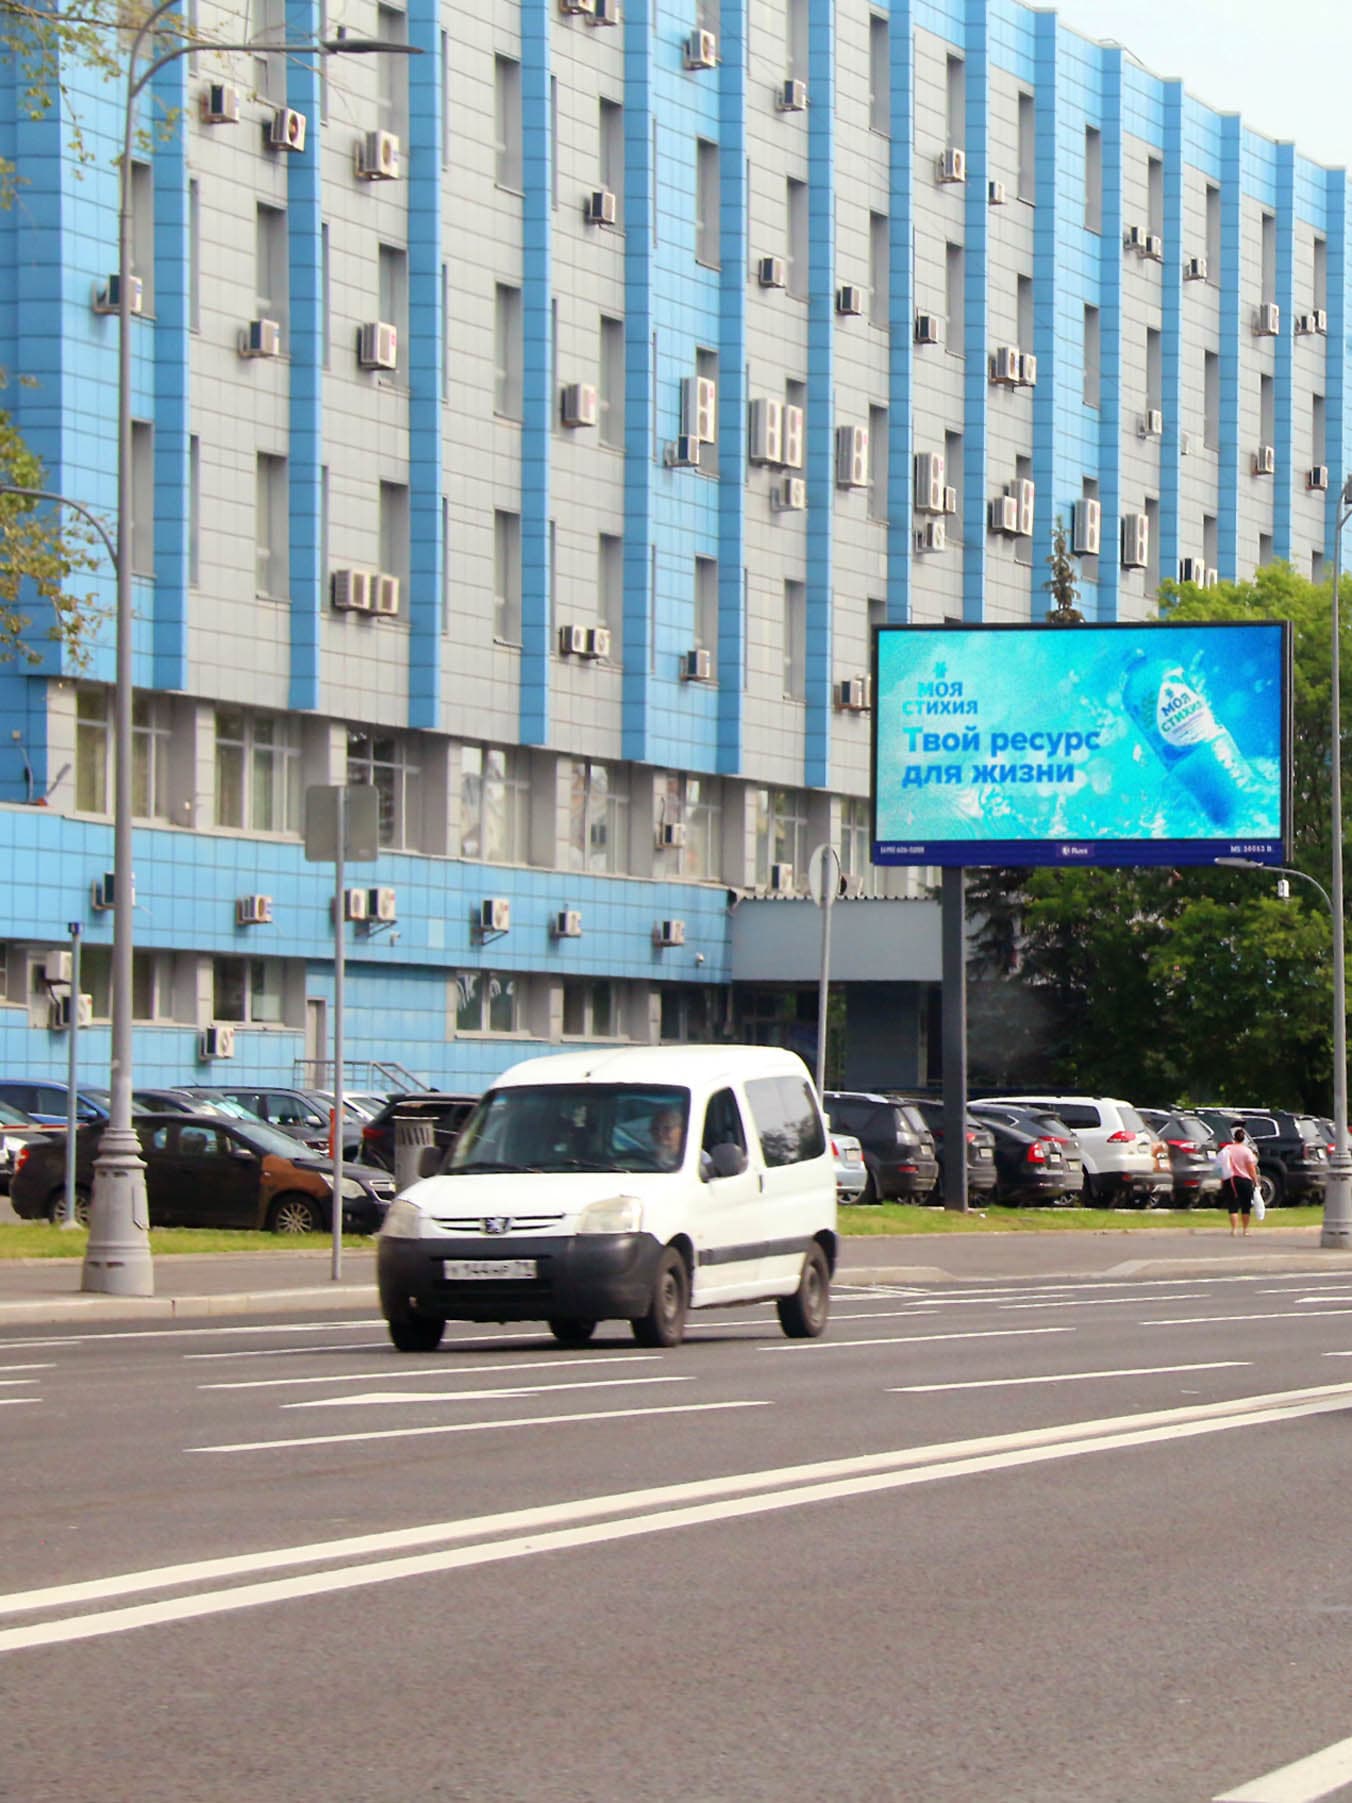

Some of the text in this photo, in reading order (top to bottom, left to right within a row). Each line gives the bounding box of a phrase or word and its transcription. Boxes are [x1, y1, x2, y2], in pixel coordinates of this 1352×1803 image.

[917, 681, 963, 698] МОЯ
[902, 700, 978, 716] СТИХИЯ
[903, 725, 1102, 758] Твой ресурс
[901, 763, 1076, 789] для жизни
